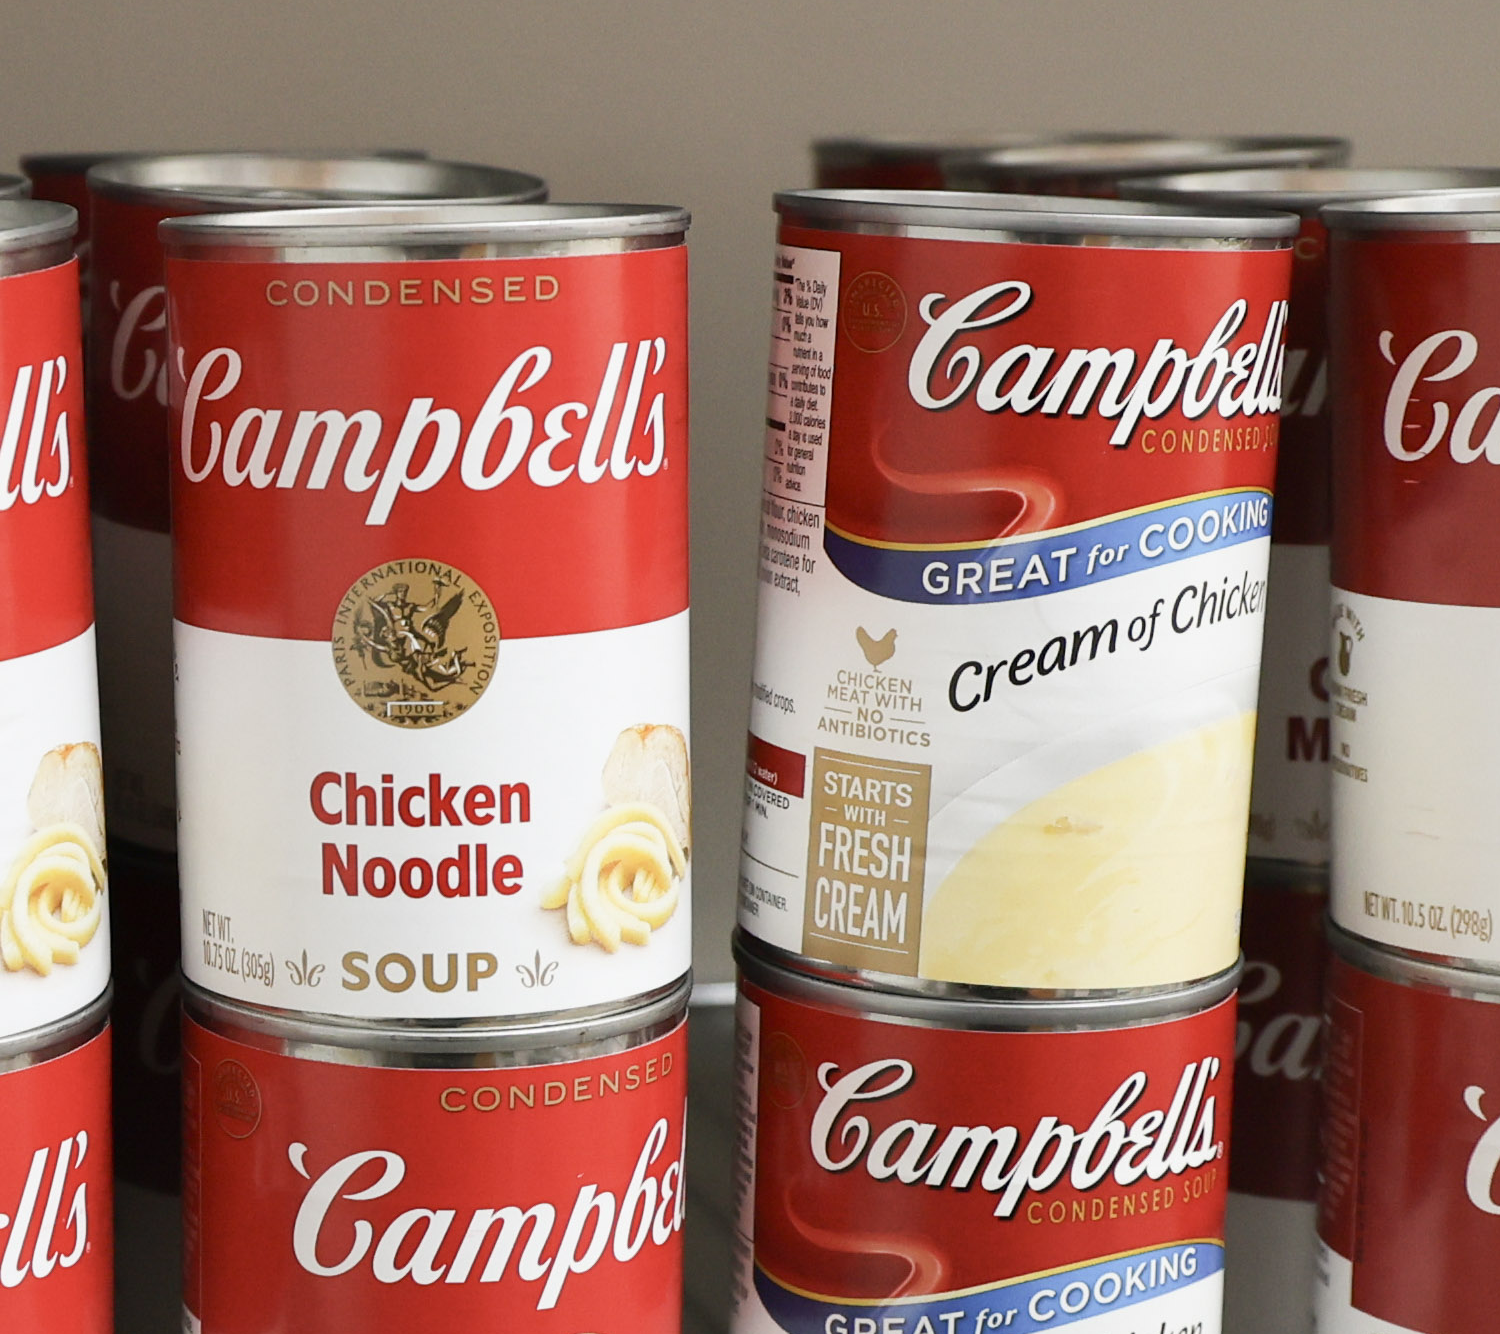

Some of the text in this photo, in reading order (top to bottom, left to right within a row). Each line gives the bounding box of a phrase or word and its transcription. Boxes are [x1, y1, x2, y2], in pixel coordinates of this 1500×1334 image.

[265, 275, 560, 309] CONDENSED
[178, 337, 667, 527] Campbell's
[1141, 427, 1260, 454] CONDENSED
[785, 506, 820, 531] chicken
[921, 497, 1269, 599] GREAT for COOKING
[333, 561, 497, 695] PARIS INTERNATIONAL EXPOSITION
[947, 568, 1267, 713] Cream of Chicken
[773, 687, 796, 714] crops.
[827, 684, 923, 713] MEAT WITH
[837, 669, 913, 694] CHICKEN
[398, 704, 435, 714] 1900
[817, 716, 931, 748] ANTIBIOTICS
[857, 706, 883, 725] NO
[308, 770, 531, 828] Chicken
[824, 770, 913, 808] STARTS
[844, 804, 886, 827] WITH
[320, 842, 524, 899] Noodle
[818, 821, 912, 883] FRESH
[202, 908, 217, 936] NET
[813, 876, 908, 944] CREAM
[1401, 900, 1426, 929] 10.5
[1451, 906, 1493, 943] (298g)
[203, 939, 223, 970] 10.75
[241, 947, 275, 988] (305g)
[341, 951, 498, 993] SOUP
[438, 1050, 675, 1114] CONDENSED
[810, 1056, 1219, 1221] Campbell's
[287, 1095, 688, 1311] Campbel
[1027, 1168, 1216, 1224] CONDENSED SOUP
[1029, 1247, 1198, 1324] COOKING
